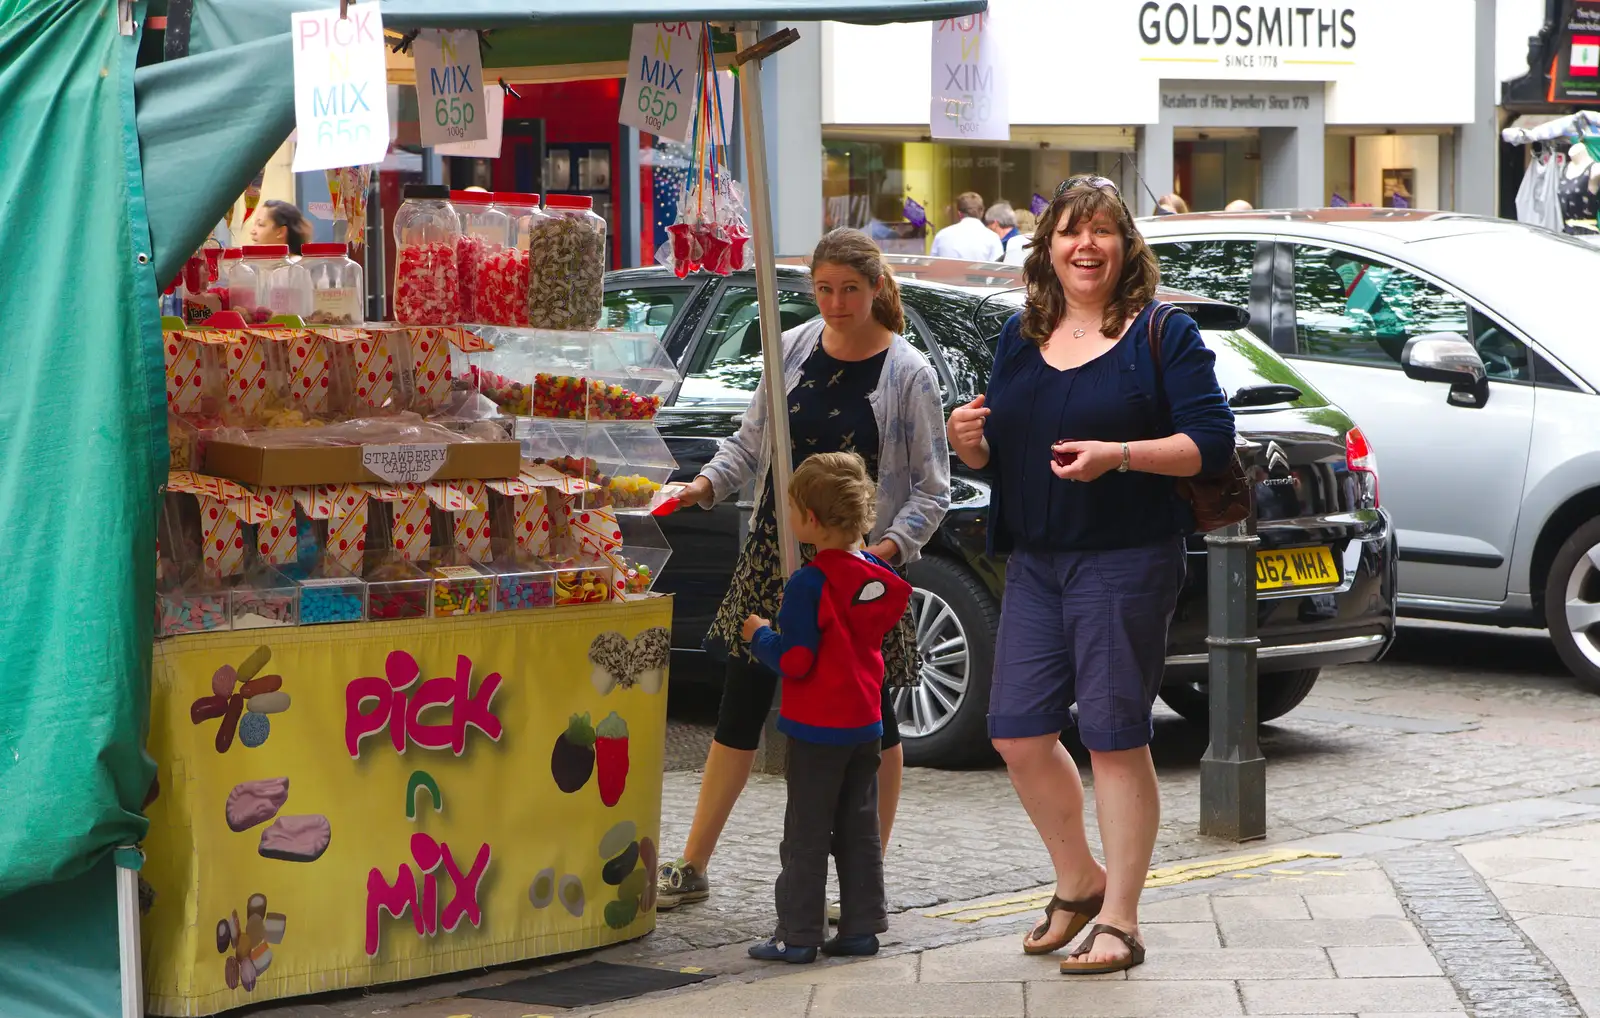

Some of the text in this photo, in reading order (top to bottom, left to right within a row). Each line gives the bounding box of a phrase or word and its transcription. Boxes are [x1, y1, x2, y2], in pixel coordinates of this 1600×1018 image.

[299, 11, 375, 51] PICK
[1138, 1, 1356, 49] GOLDSMITHS
[441, 34, 458, 65] N
[655, 30, 672, 62] N
[1225, 55, 1278, 68] SINCE 1778
[330, 50, 351, 82] N
[430, 64, 474, 96] MIX
[641, 55, 683, 94] MIX
[313, 81, 371, 117] MIX
[434, 97, 475, 130] 65p
[638, 86, 678, 126] 65p
[1162, 94, 1197, 109] Retailers
[1200, 94, 1209, 109] of
[1211, 95, 1228, 109] Fine
[1230, 95, 1266, 112] Jewellery
[1269, 96, 1290, 110] Since
[446, 126, 464, 138] 100g
[645, 115, 662, 130] 100g
[363, 449, 446, 465] STRAWBERRY
[383, 461, 432, 474] CABLES
[399, 471, 419, 482] 70p
[1291, 551, 1330, 580] MHA
